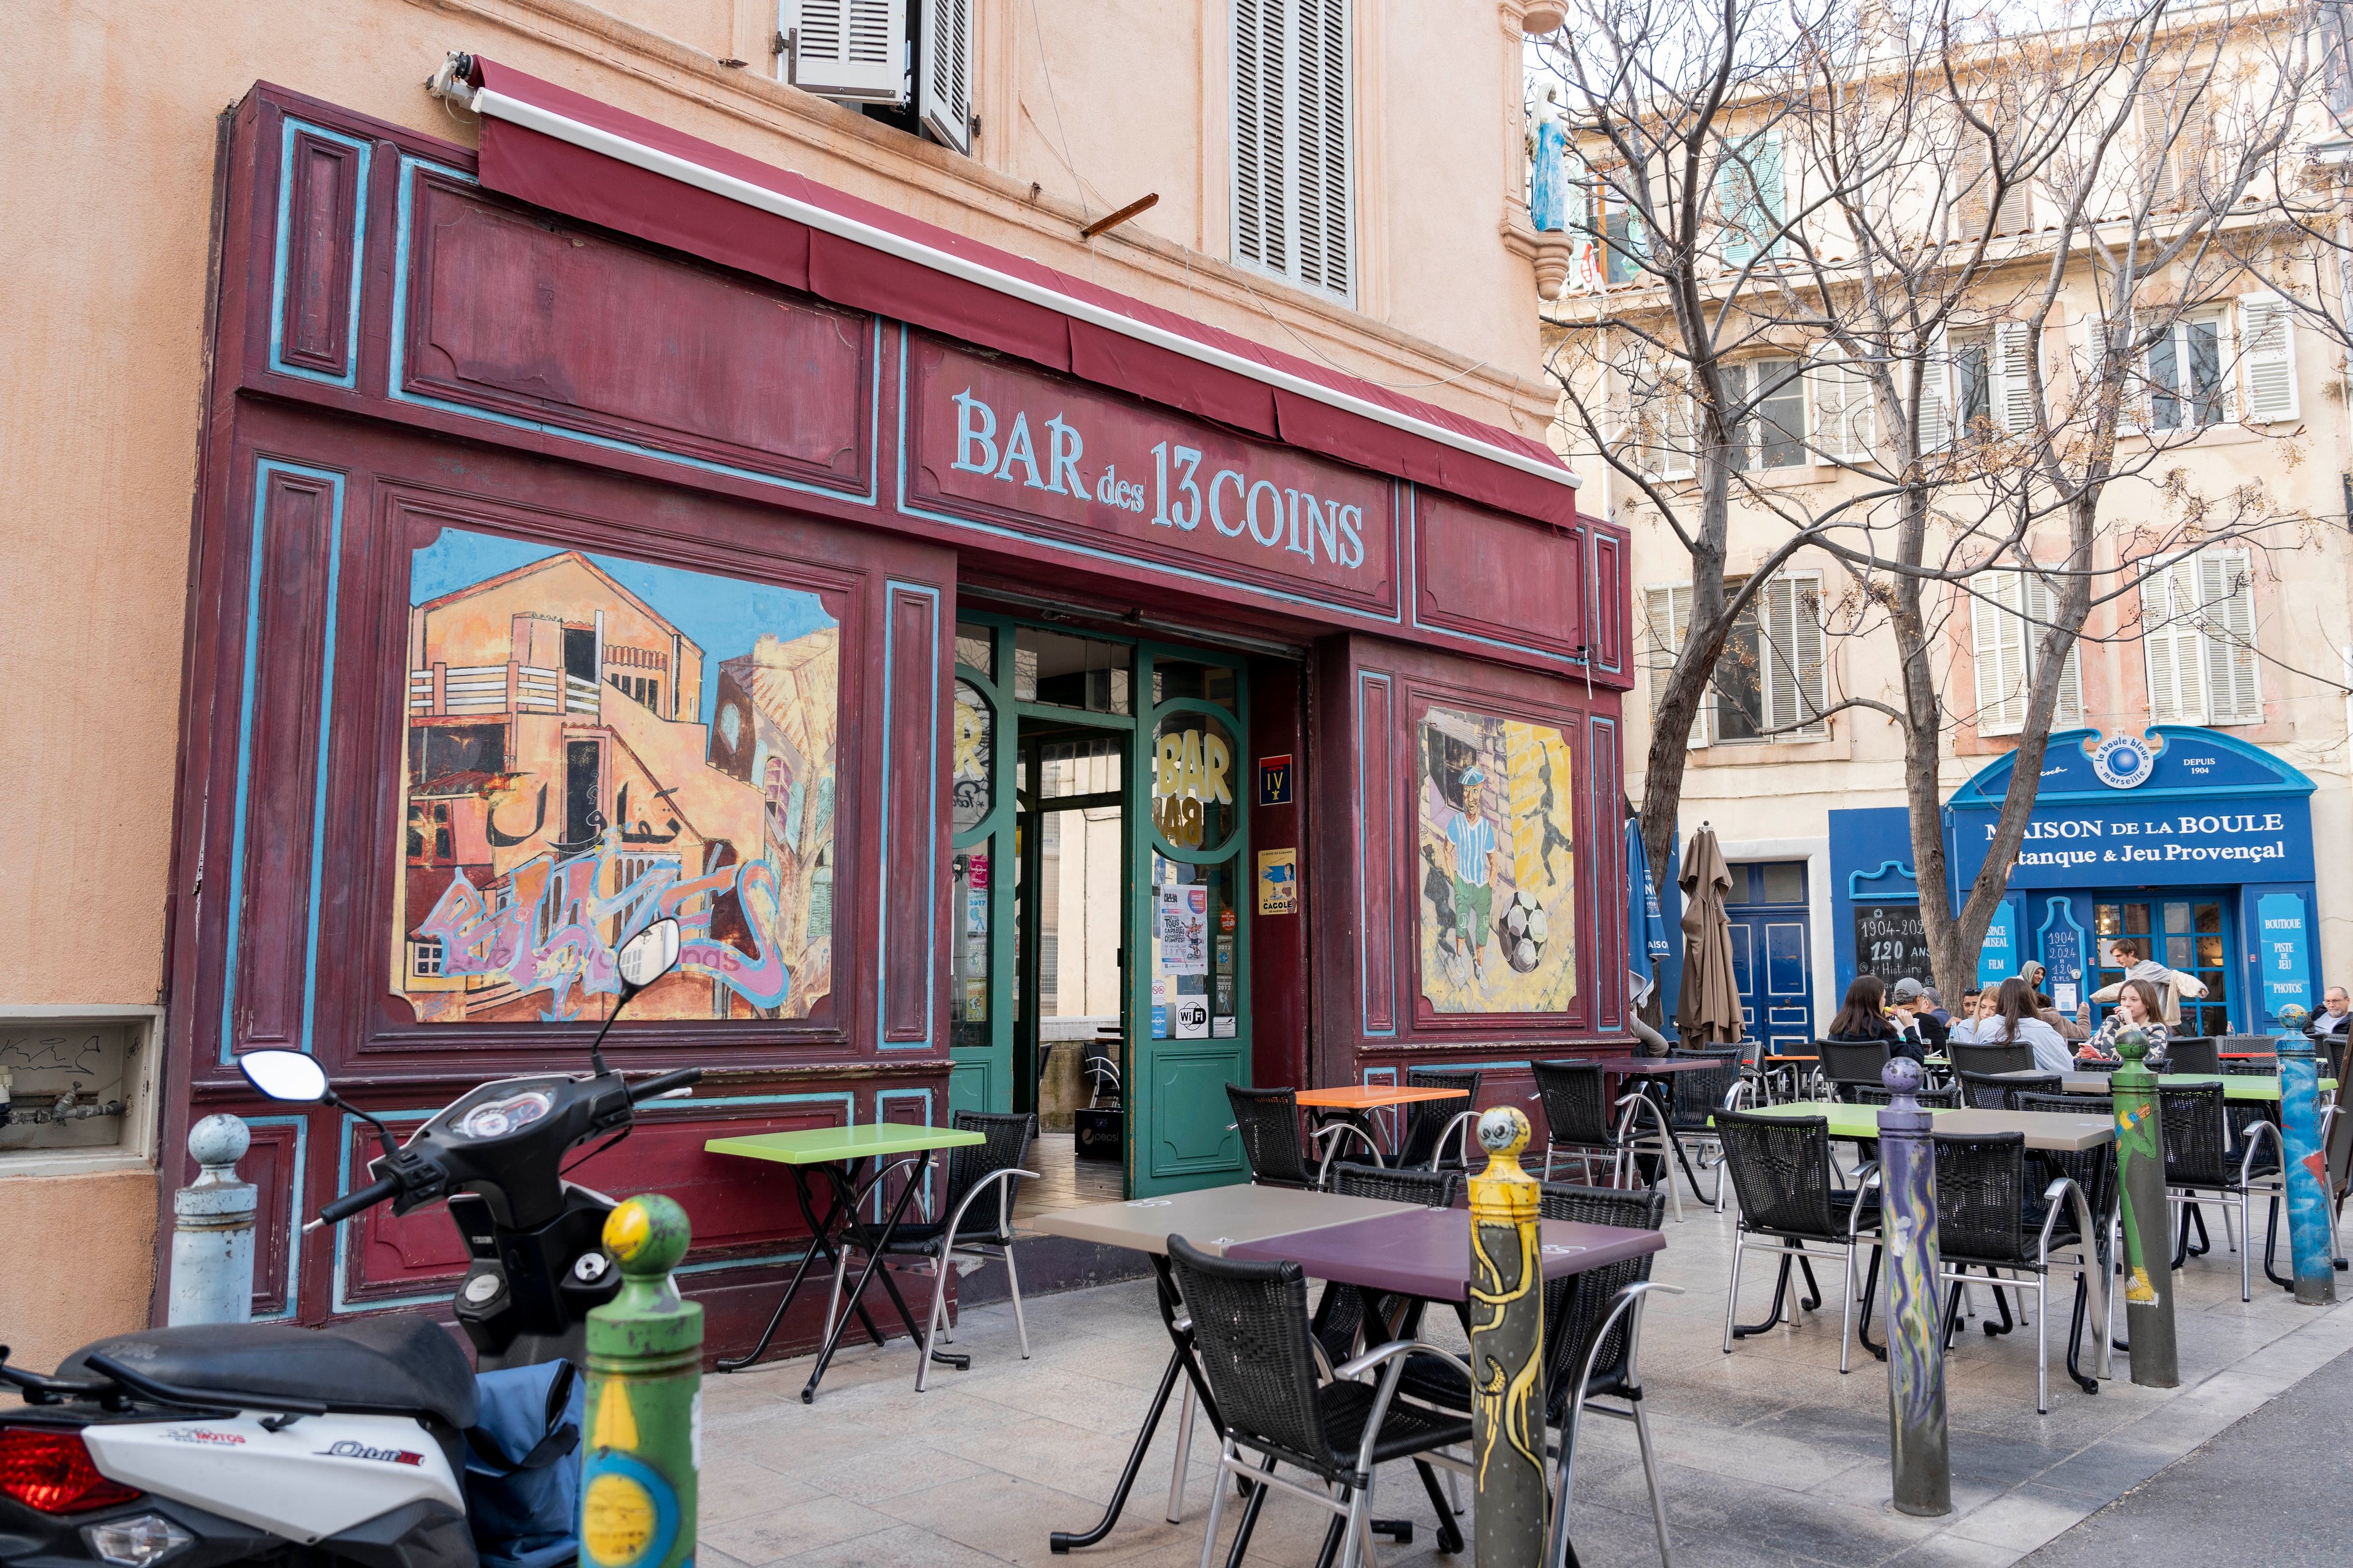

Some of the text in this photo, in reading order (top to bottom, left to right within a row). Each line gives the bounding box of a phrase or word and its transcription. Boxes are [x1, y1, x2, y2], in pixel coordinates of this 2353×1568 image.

[950, 385, 1365, 569] BAR des 13 COINS
[2100, 737, 2127, 752] boule
[2130, 739, 2149, 760] bleue
[1156, 729, 1233, 805] BAR
[2184, 758, 2216, 766] DEPUIS
[2103, 771, 2145, 785] marseille
[1985, 813, 2284, 840] ISON DE LA BOULE
[2103, 849, 2118, 862] &
[2121, 845, 2162, 862] Jeu
[2163, 841, 2285, 863] Provençal
[1263, 901, 1292, 910] CAGOLE
[1164, 918, 1179, 928] TOUS
[1861, 919, 1924, 937] 1904-202
[2265, 918, 2302, 929] BOUTIQUE
[1164, 926, 1185, 934] CAPABLES
[1982, 937, 2009, 947] MUSEAL
[2047, 932, 2075, 944] 1904
[1870, 941, 1930, 960] 120 ANS
[2049, 947, 2076, 959] 2024
[2274, 943, 2294, 952] PISTE
[1988, 959, 2004, 970] FILM
[2051, 964, 2072, 975] 120
[2278, 960, 2292, 970] JEU
[2273, 983, 2302, 993] PHOTOS
[1094, 1132, 1118, 1143] pepsi
[195, 1430, 246, 1443] MOTOS
[329, 1440, 401, 1462] Orbit
